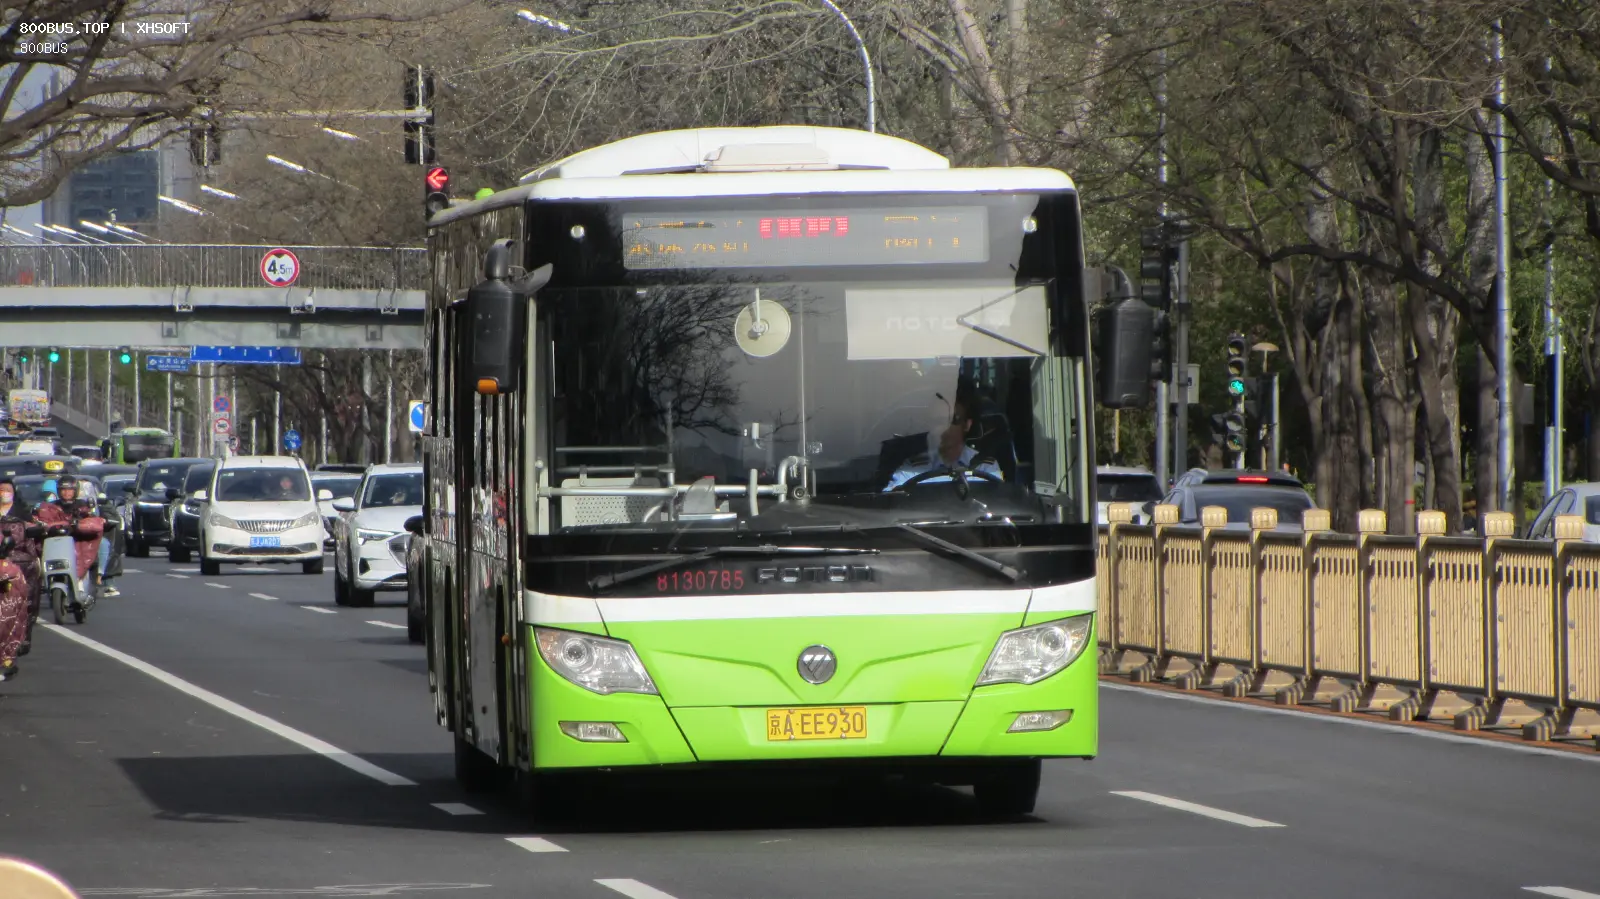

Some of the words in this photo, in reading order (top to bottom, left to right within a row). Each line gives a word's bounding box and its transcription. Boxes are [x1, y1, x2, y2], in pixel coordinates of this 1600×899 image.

[267, 259, 293, 275] 4.5m
[657, 570, 744, 591] 8130785
[757, 565, 873, 584] FOTON
